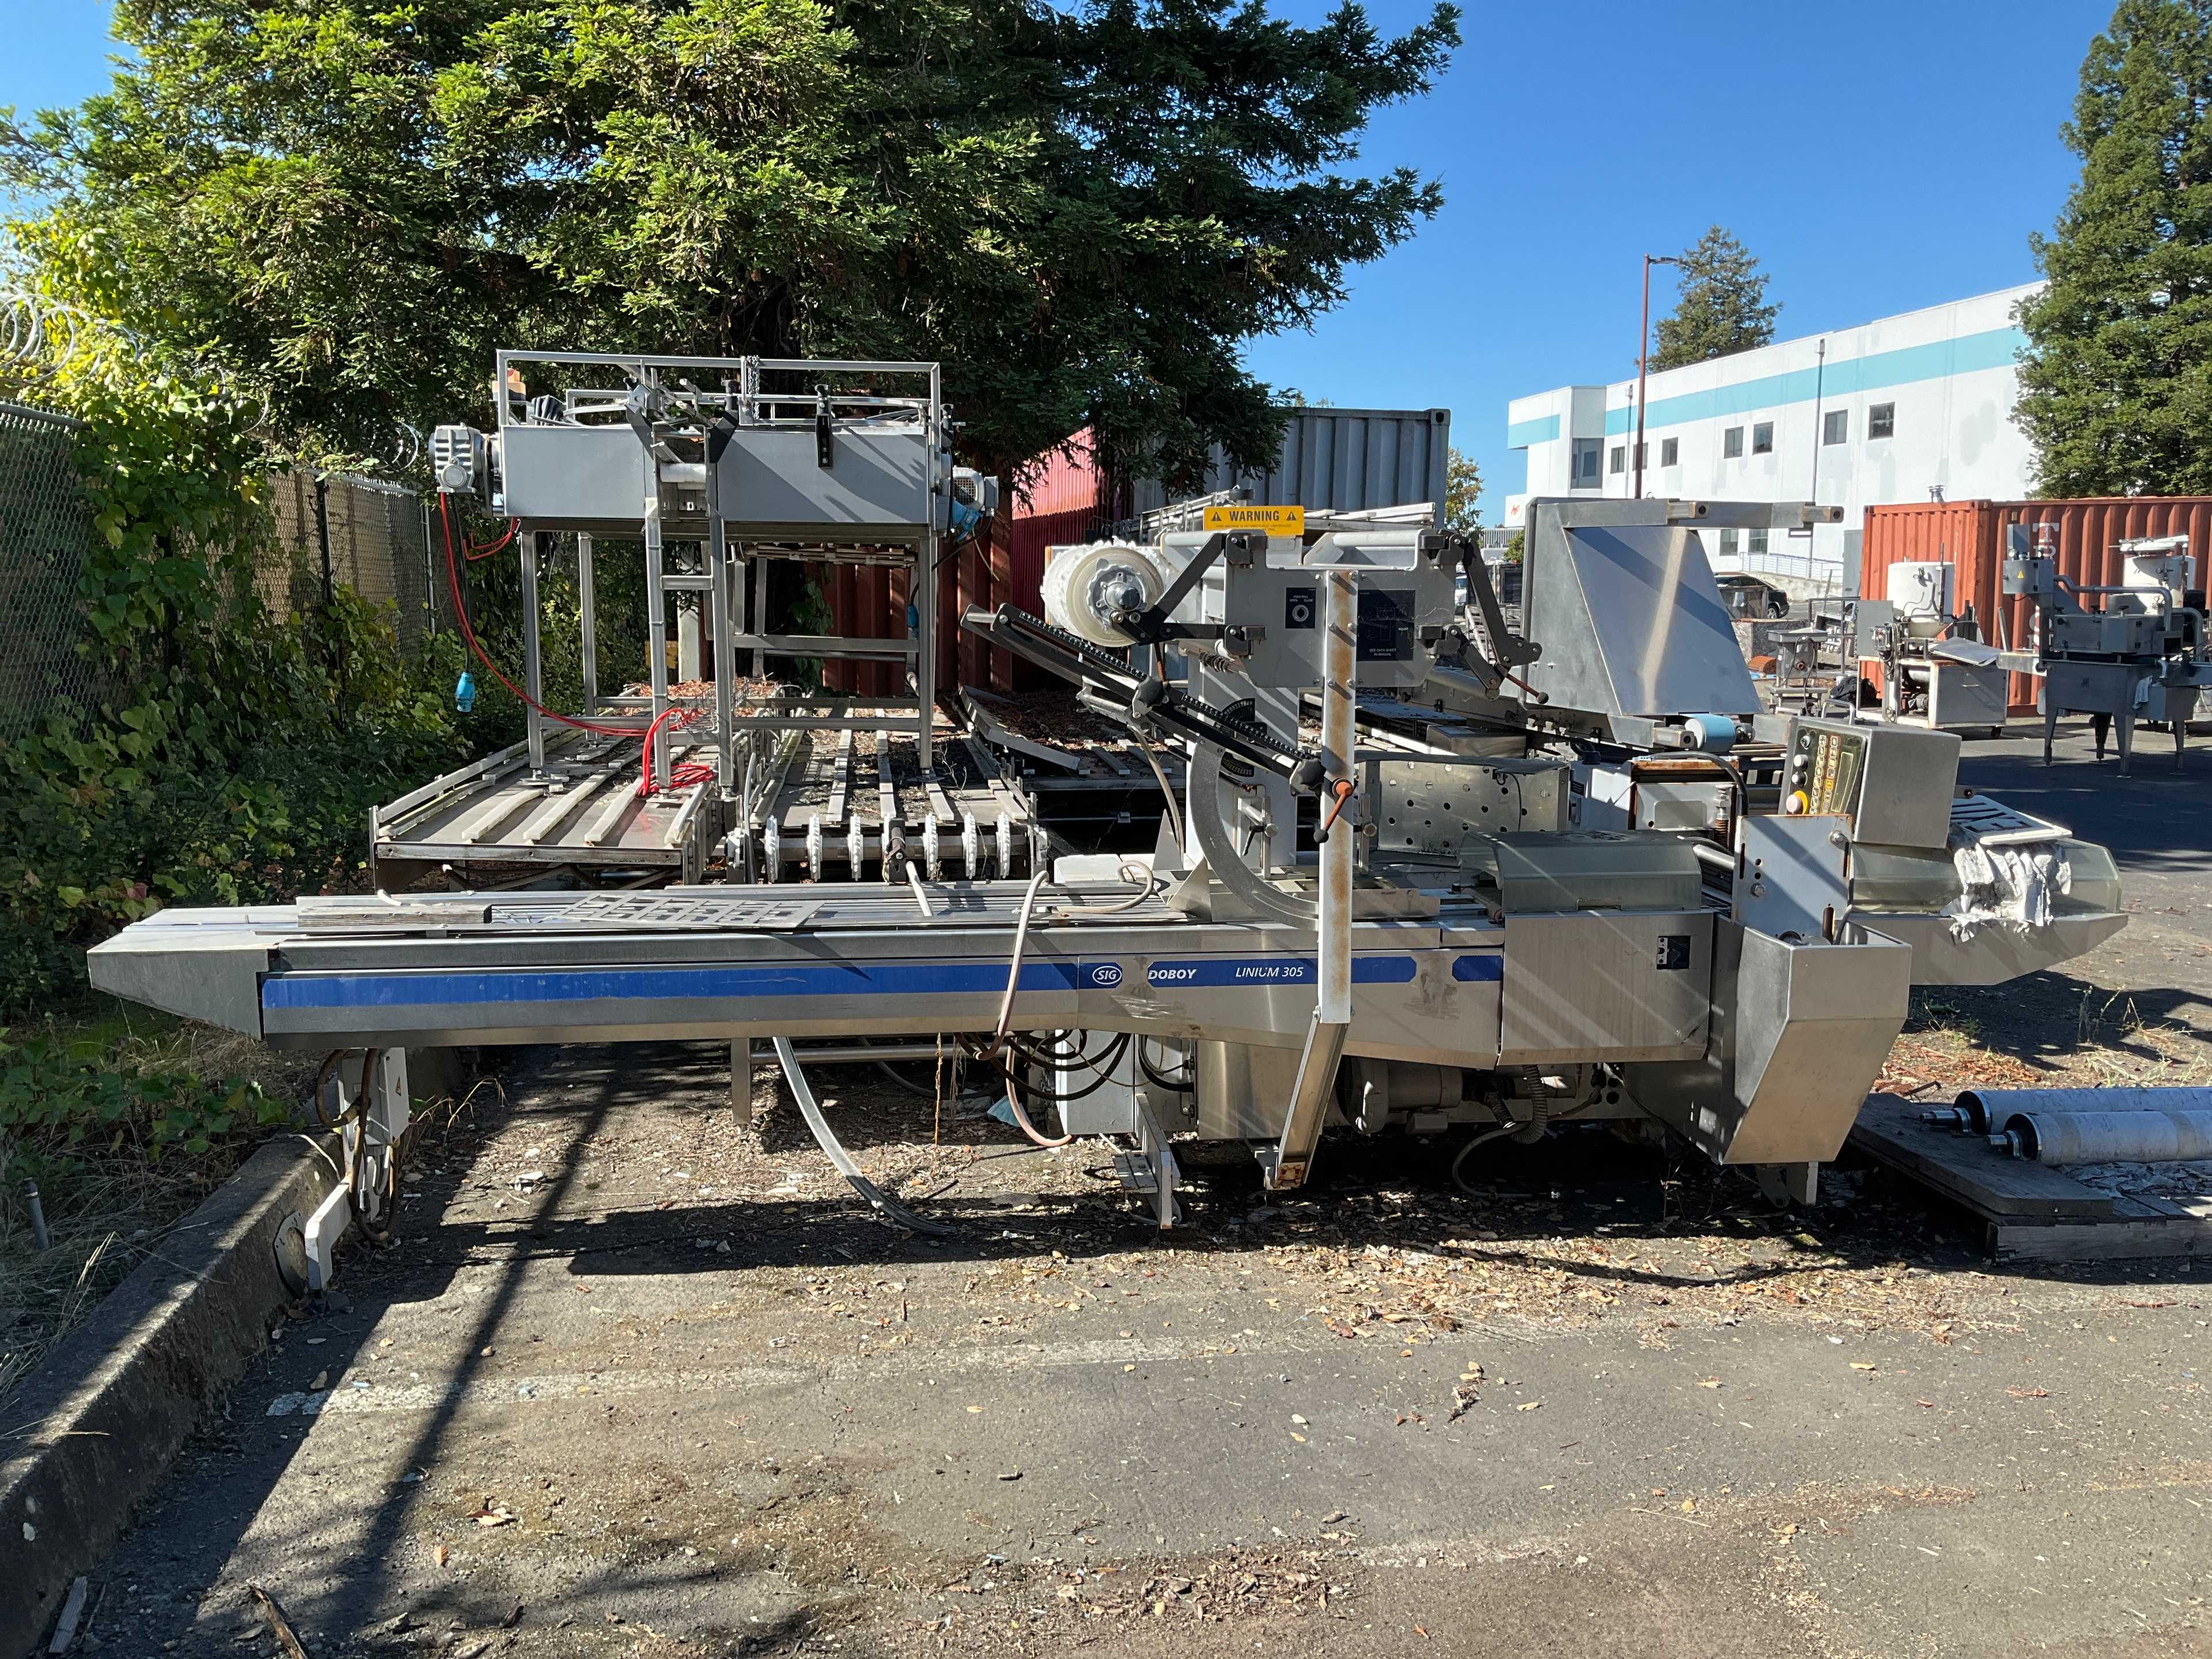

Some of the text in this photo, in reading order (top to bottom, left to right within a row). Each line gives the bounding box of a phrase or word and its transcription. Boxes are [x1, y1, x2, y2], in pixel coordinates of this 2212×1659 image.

[1229, 510, 1279, 521] WARNING
[1097, 967, 1304, 980] SIG DOBOY LINIUM 305
